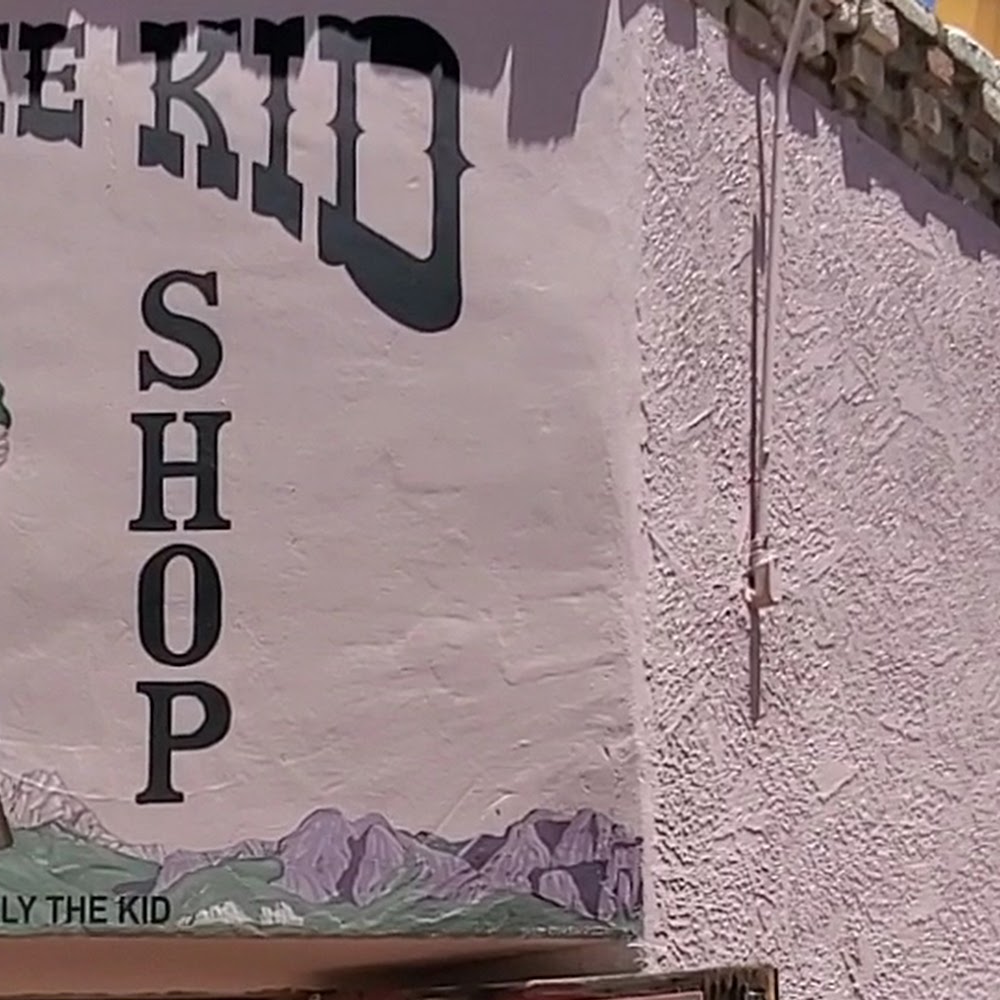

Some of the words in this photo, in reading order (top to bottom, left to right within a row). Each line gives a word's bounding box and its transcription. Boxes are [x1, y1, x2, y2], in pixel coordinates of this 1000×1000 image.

[138, 15, 476, 333] KID
[128, 269, 232, 804] SHOP
[46, 894, 108, 924] THE
[118, 895, 171, 925] KID
